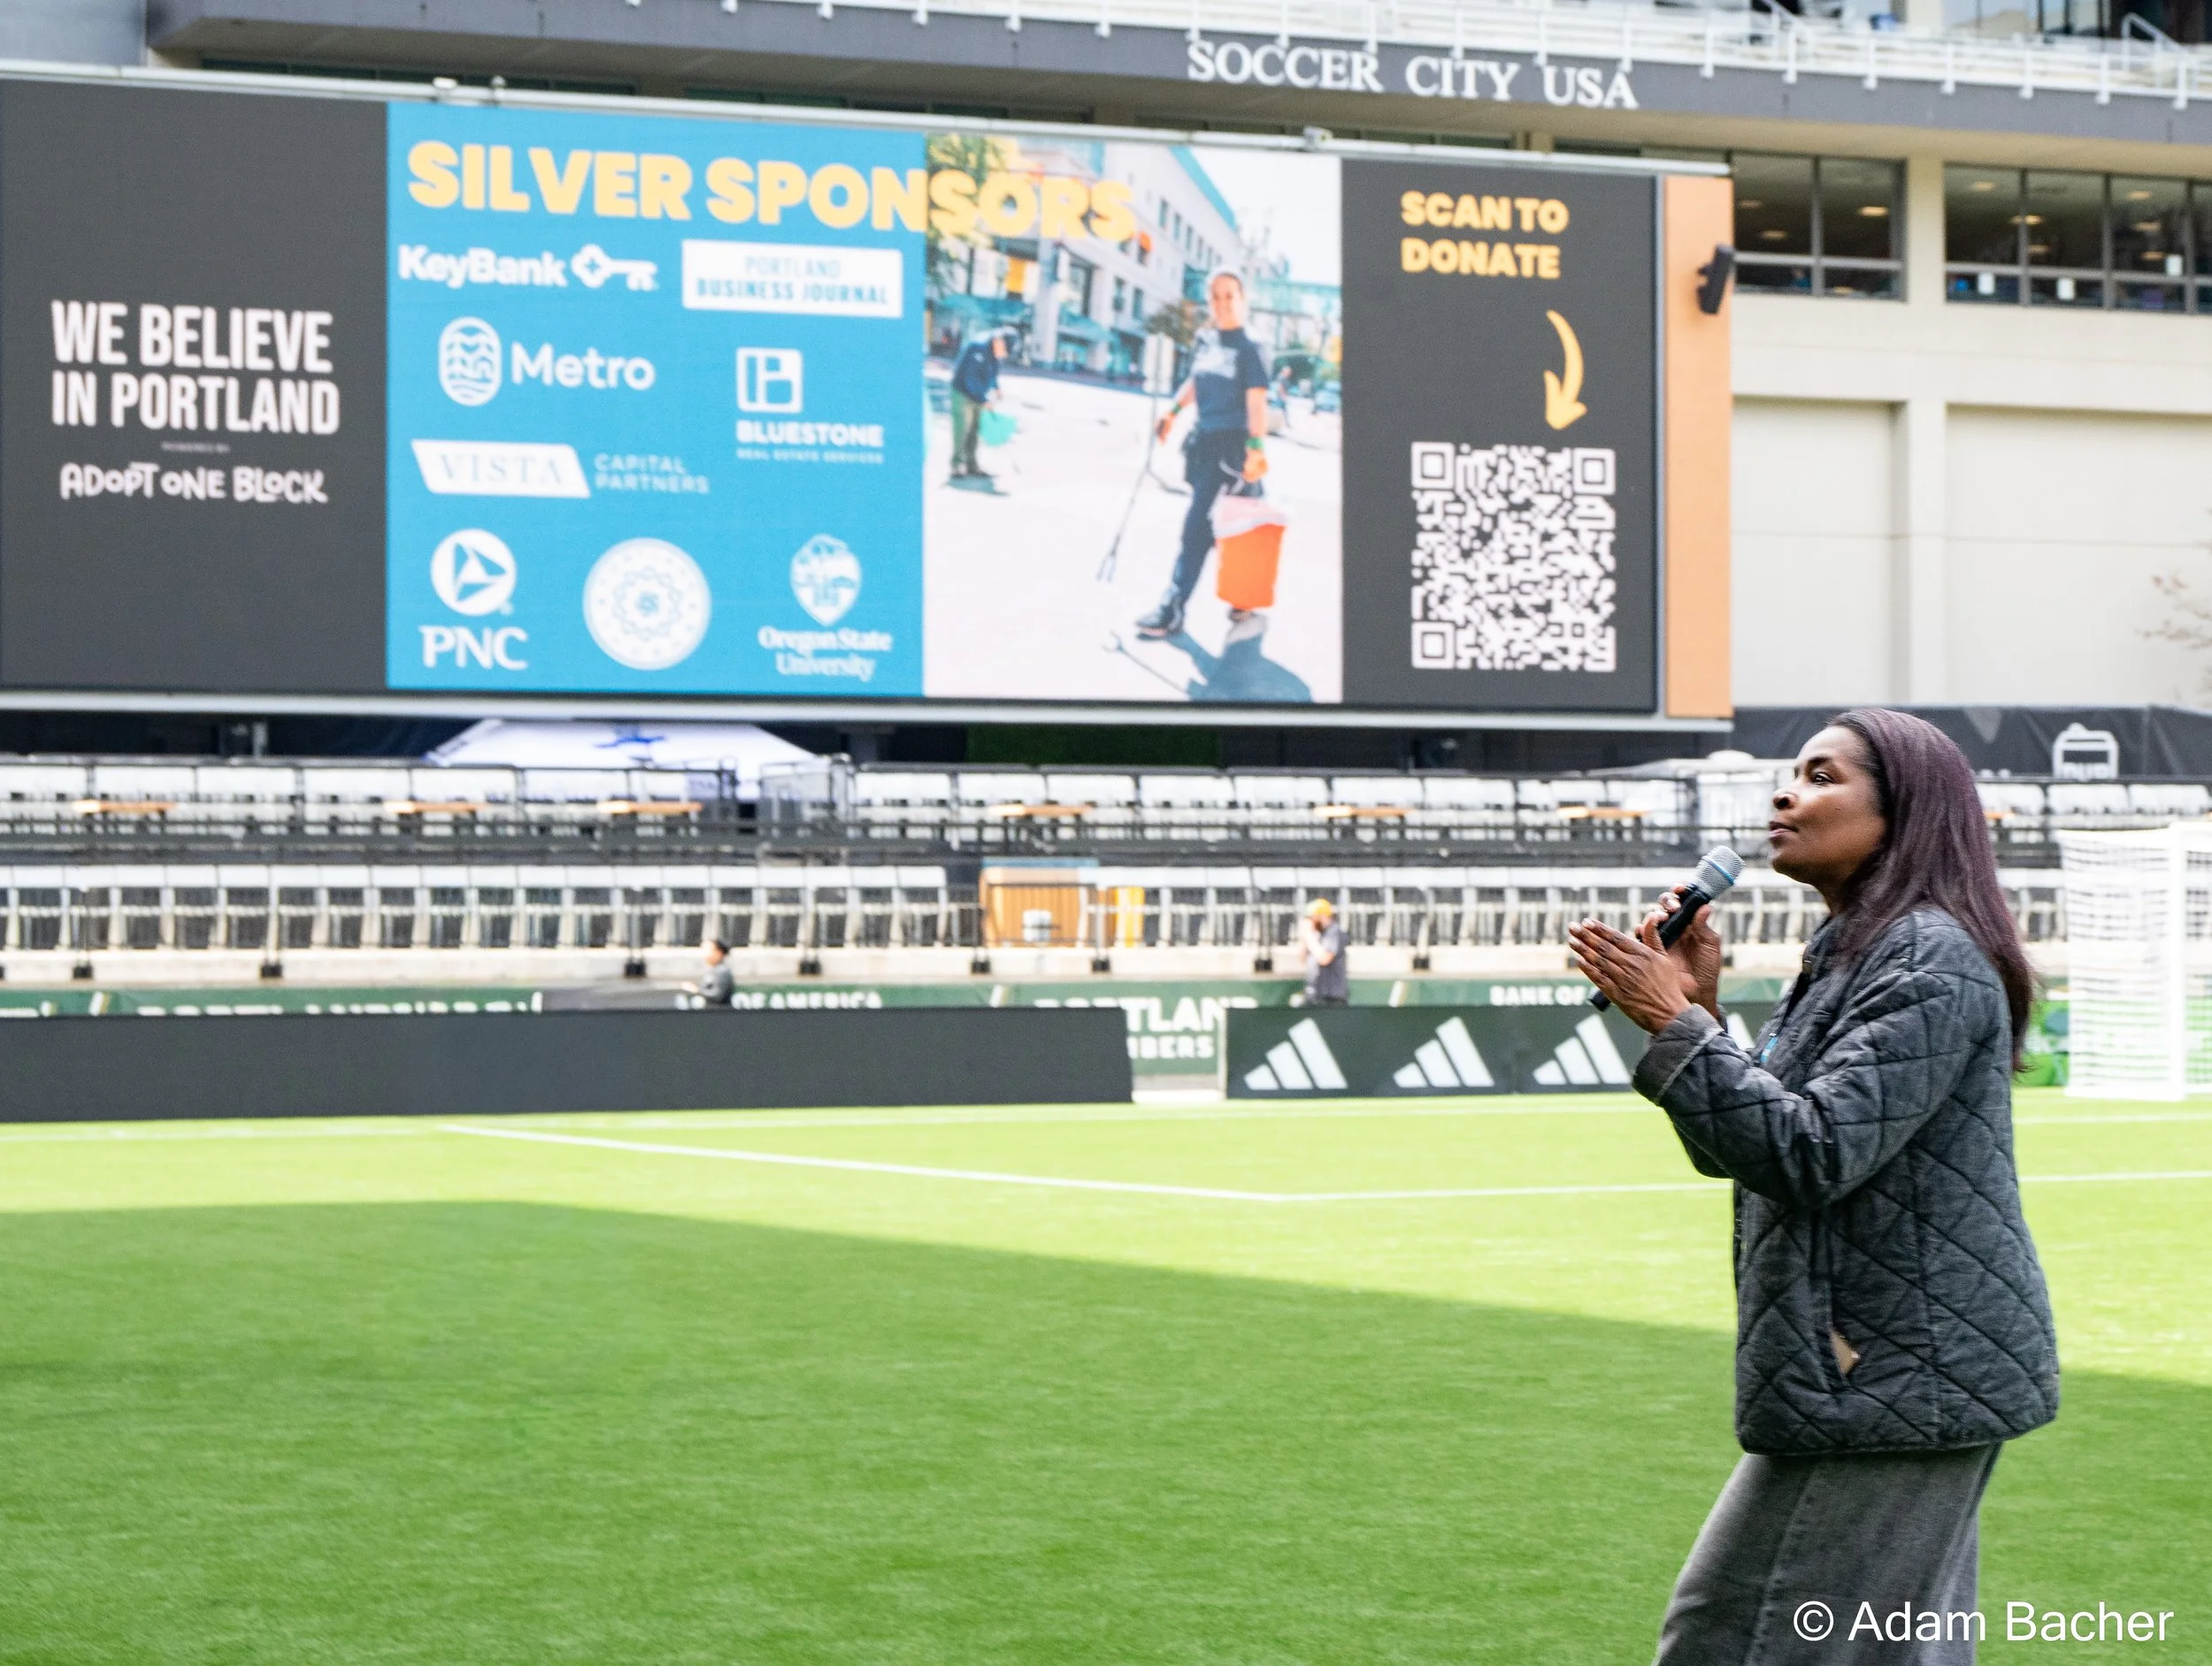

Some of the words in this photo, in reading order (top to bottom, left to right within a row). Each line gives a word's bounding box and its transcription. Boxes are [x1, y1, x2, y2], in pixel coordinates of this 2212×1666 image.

[1187, 39, 1384, 93] SOCCER
[1405, 55, 1520, 102] CITY
[1541, 65, 1640, 111] USA
[408, 140, 693, 220] SILVER
[706, 157, 1136, 242] SPONSORS
[1401, 190, 1511, 230] SCAN
[1514, 197, 1570, 234] TO
[398, 243, 569, 289] KeyBank
[745, 255, 841, 279] PORTLAND
[1401, 237, 1562, 279] DONATE
[697, 278, 795, 302] BUSINESS
[801, 281, 888, 305] JOURNAL
[51, 300, 128, 365] WE
[139, 303, 333, 373] BELIEVE
[511, 341, 657, 390] Metro
[52, 369, 96, 426] IN
[111, 372, 341, 435] PORTLAND
[736, 419, 884, 448] BLUESTONE
[439, 452, 563, 486] VISTA
[594, 452, 687, 474] CAPITAL
[594, 472, 710, 495] PARTNERS
[419, 625, 529, 671] PNC
[757, 626, 837, 658] Oregon
[837, 626, 894, 651] State
[775, 651, 876, 683] University
[1489, 985, 1554, 1007] BANK
[1555, 985, 1586, 1007] OF
[1125, 1035, 1215, 1059] BERS
